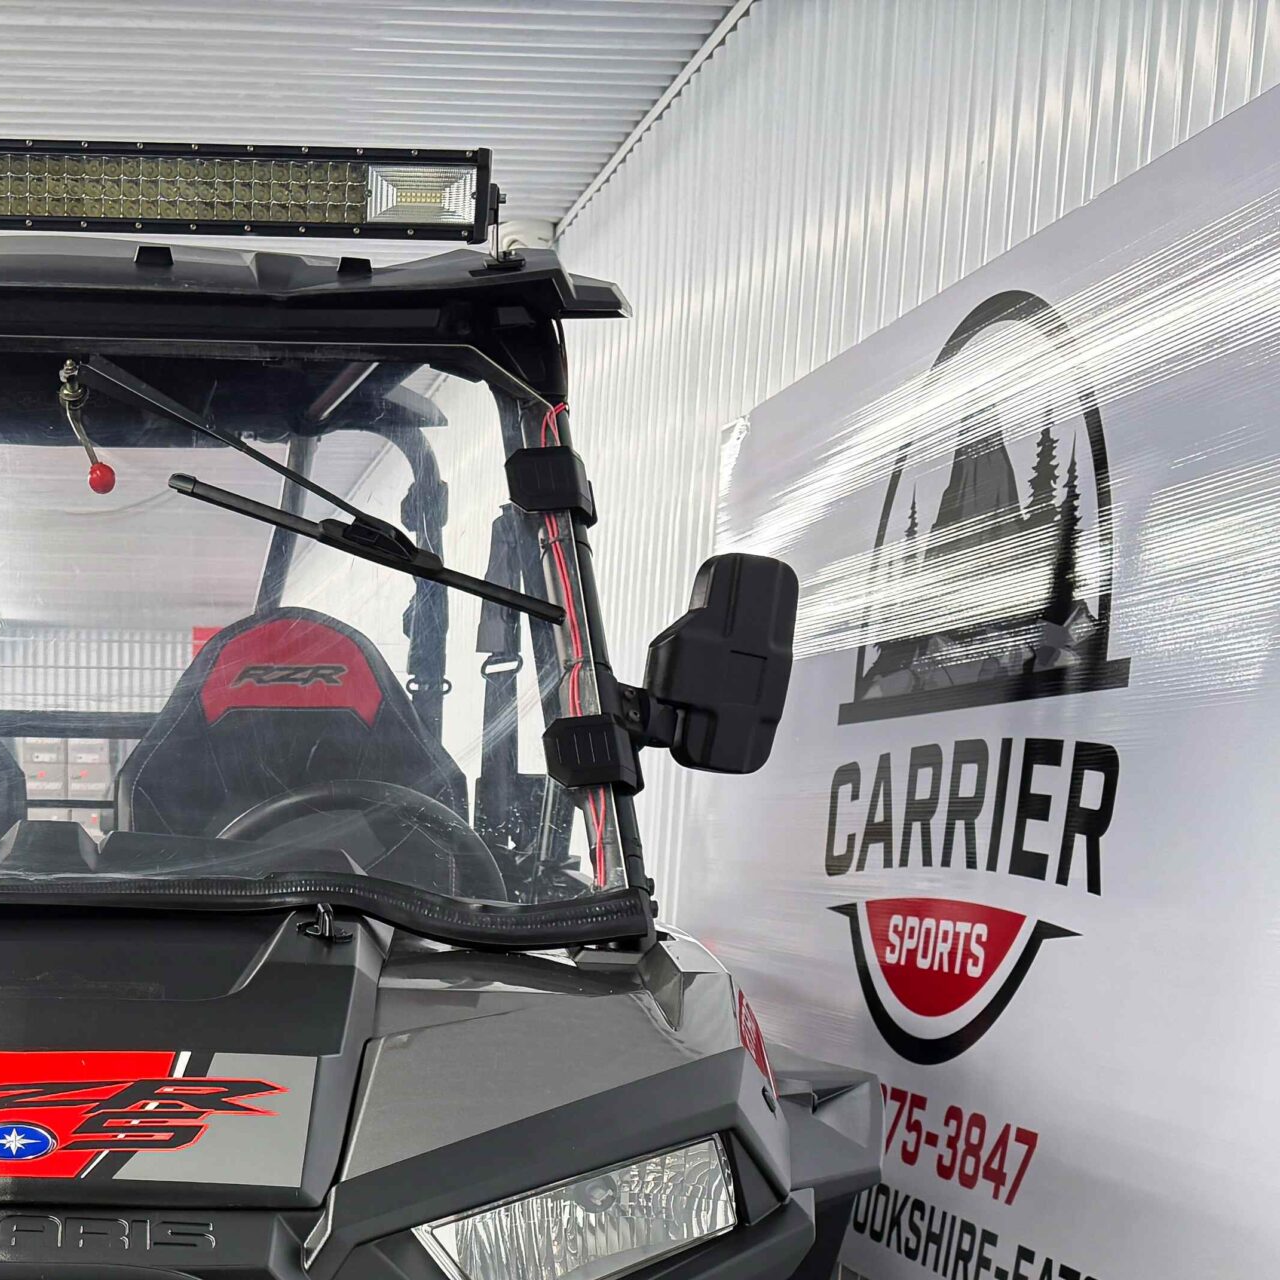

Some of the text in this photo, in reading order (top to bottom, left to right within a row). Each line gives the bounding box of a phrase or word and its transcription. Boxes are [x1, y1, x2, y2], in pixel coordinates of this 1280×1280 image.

[229, 663, 349, 689] RZR
[824, 737, 1120, 897] CARRIER
[885, 914, 989, 979] SPORTS
[881, 1082, 1039, 1206] 75-3847
